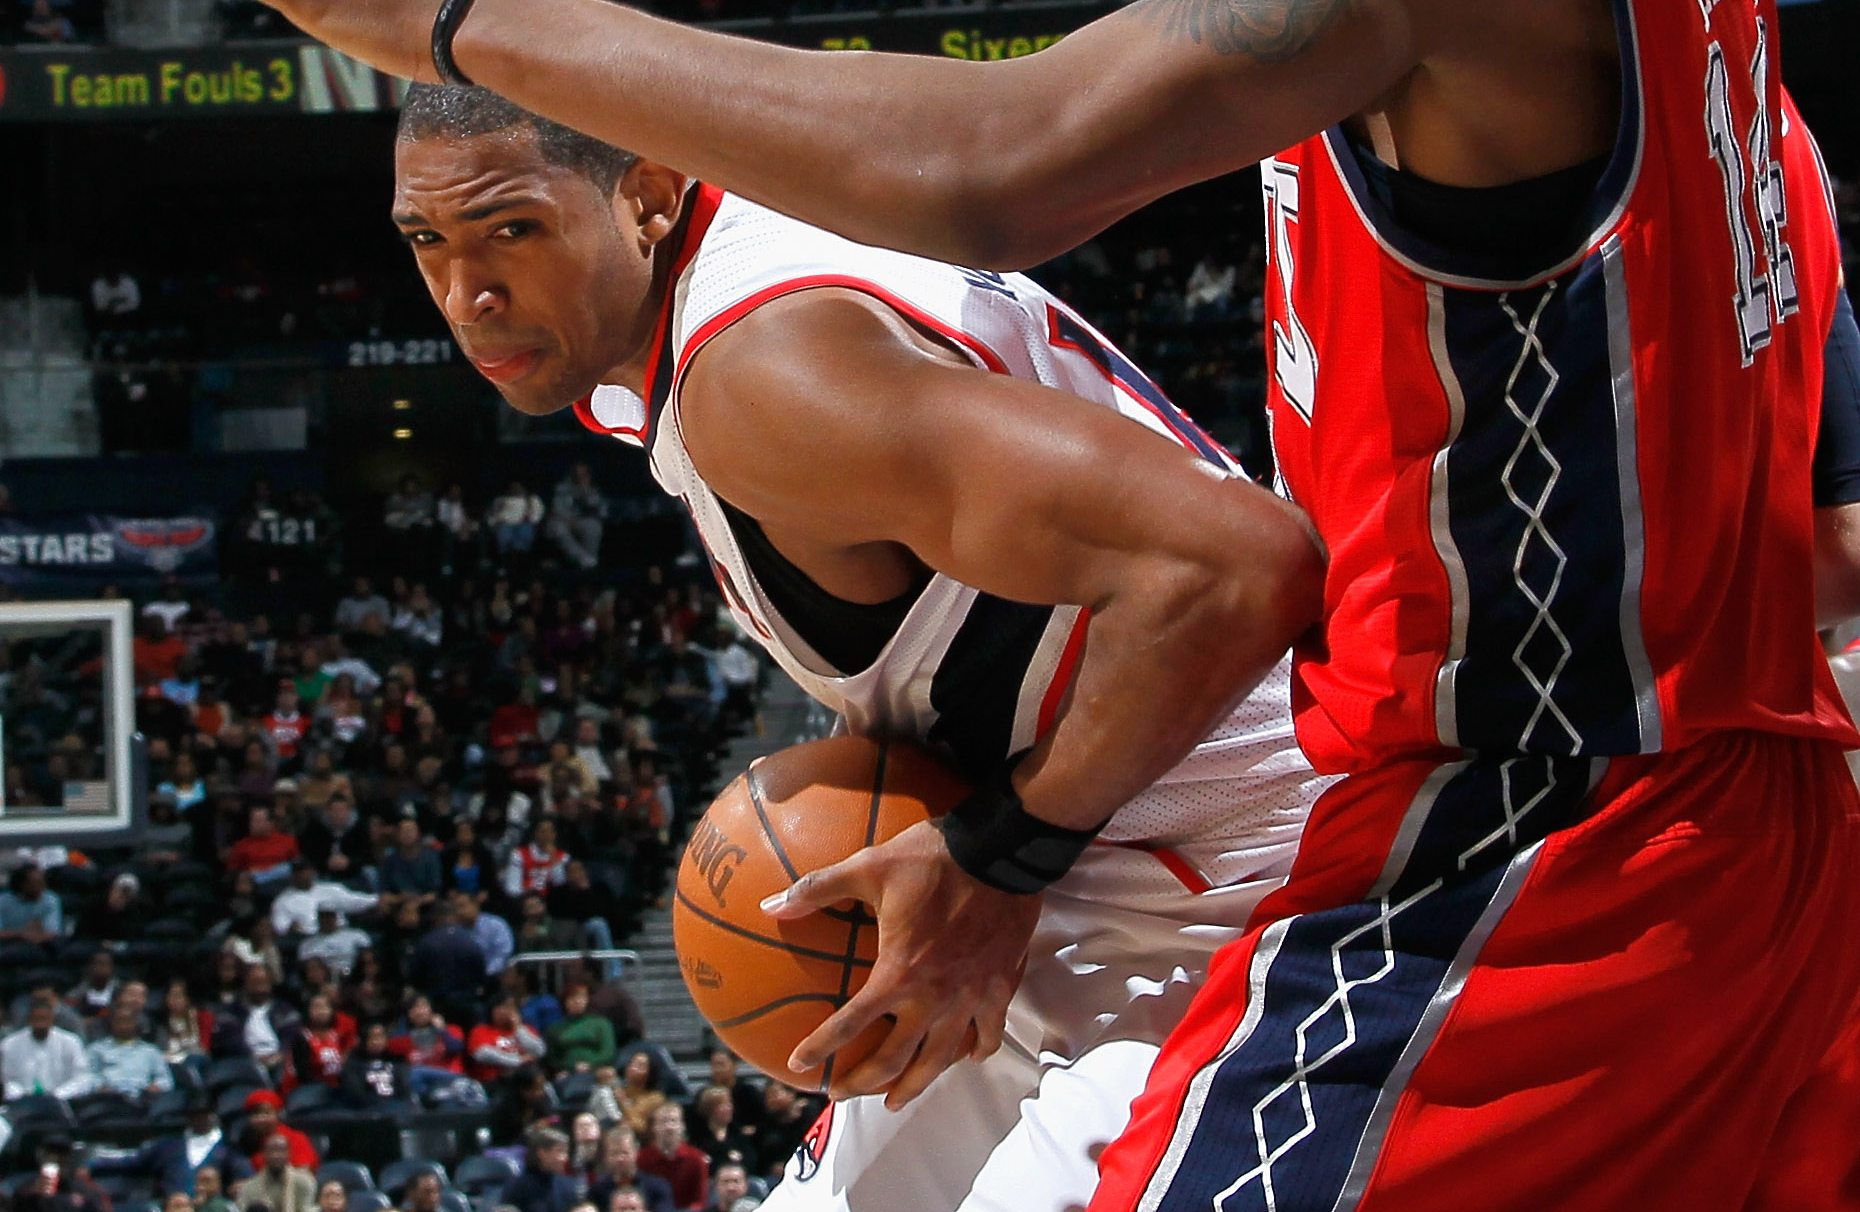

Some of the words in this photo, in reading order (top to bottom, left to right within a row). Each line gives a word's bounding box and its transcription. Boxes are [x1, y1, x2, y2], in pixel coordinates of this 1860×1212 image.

[47, 64, 149, 107] Team
[160, 61, 262, 105] Fouls
[269, 58, 294, 102] 3
[0, 533, 115, 564] STARS
